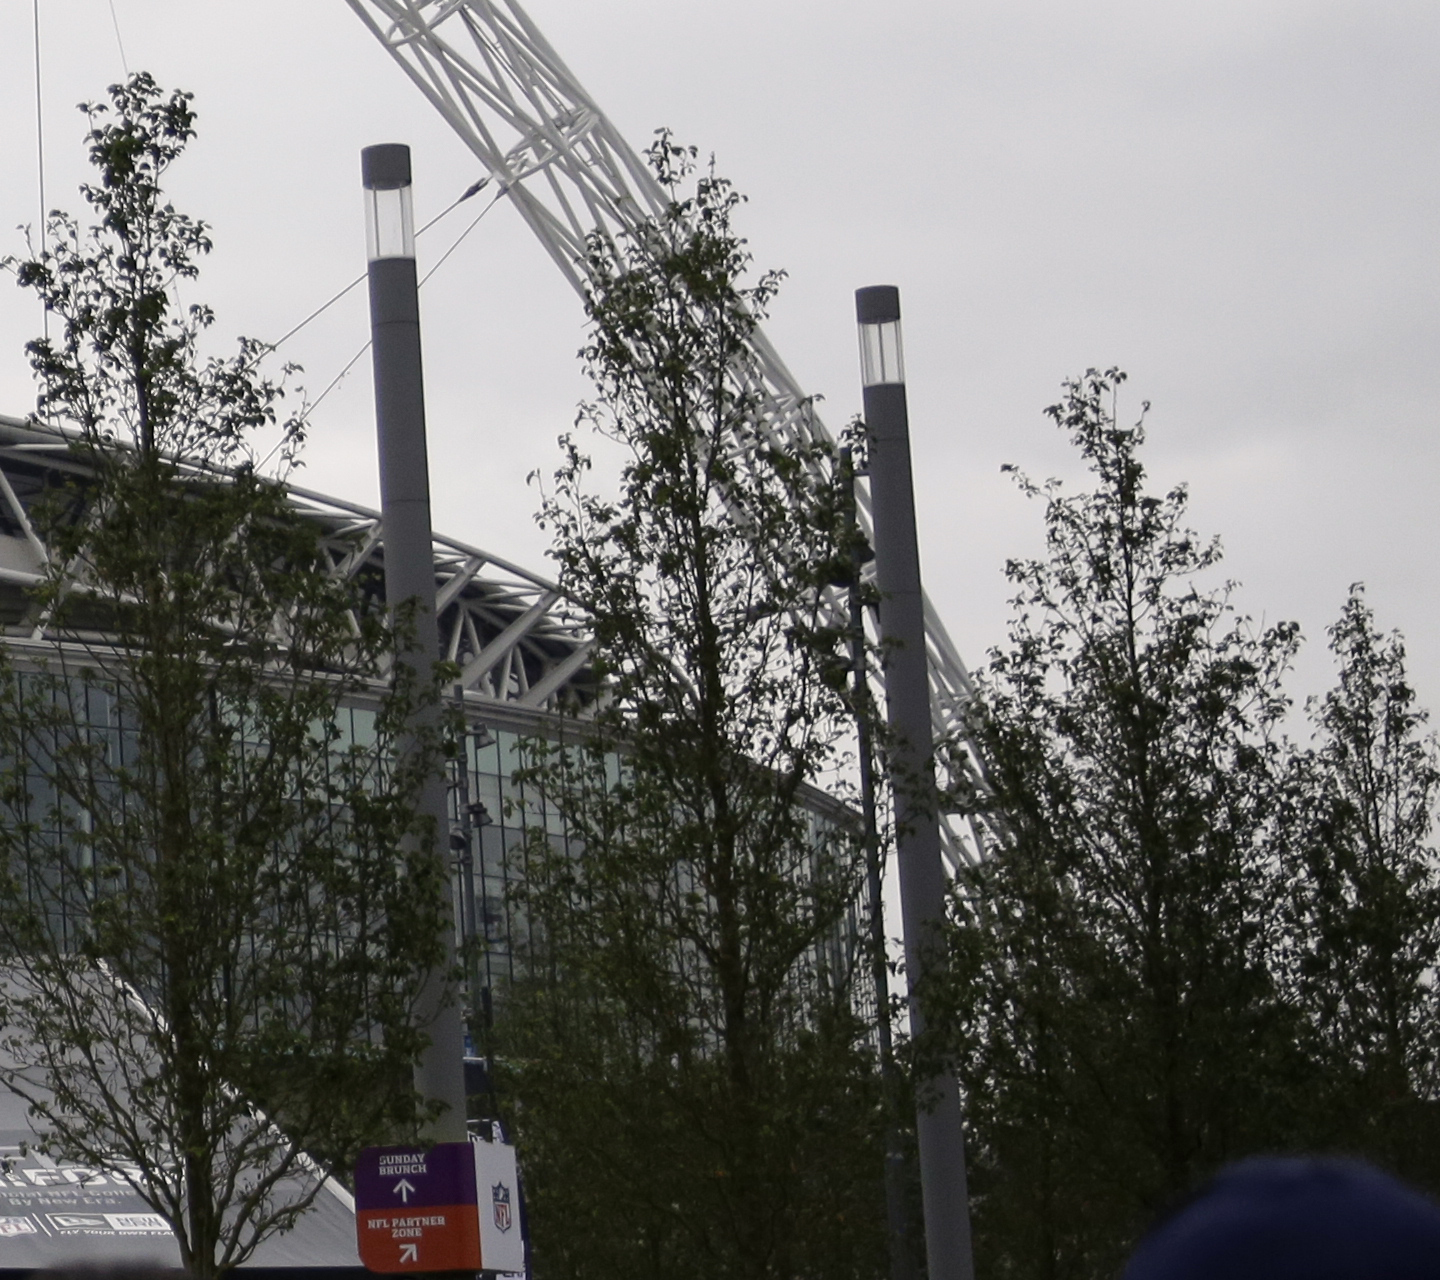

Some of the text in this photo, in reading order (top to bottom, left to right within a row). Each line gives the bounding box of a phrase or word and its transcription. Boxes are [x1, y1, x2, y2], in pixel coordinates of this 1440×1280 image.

[379, 1153, 425, 1165] SUNDAY
[379, 1164, 427, 1175] BRUNCH
[9, 1198, 34, 1207] By
[38, 1197, 78, 1206] New
[494, 1201, 511, 1228] NFL
[367, 1216, 446, 1229] NFL PARTNER
[392, 1228, 422, 1238] ZONE
